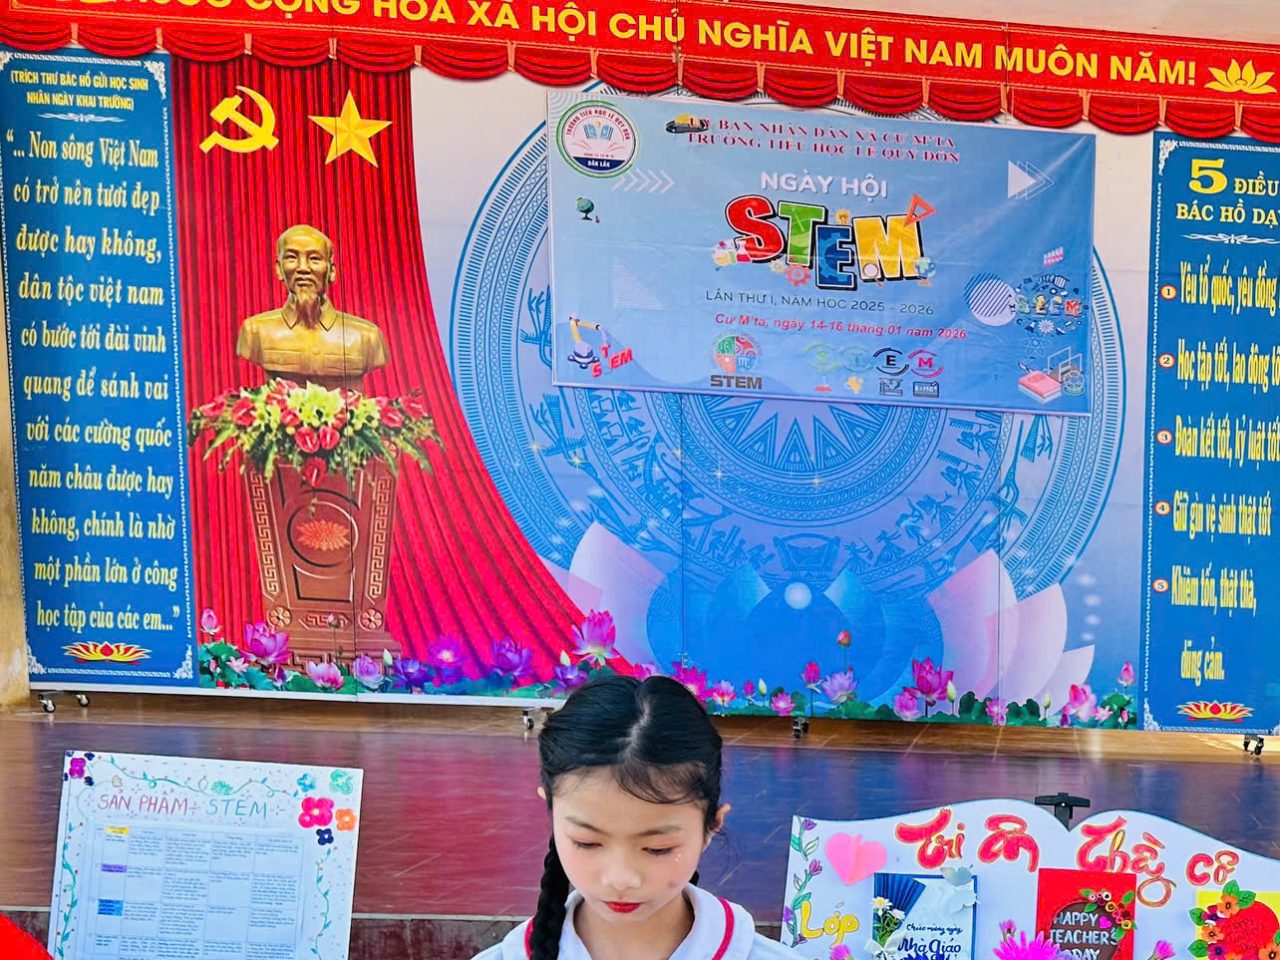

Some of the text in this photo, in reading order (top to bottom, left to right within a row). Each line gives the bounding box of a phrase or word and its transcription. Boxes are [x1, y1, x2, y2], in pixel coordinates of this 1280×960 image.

[531, 1, 597, 42] HỘI
[609, 8, 685, 43] CHỦ
[698, 19, 814, 55] NGHĨA
[825, 27, 894, 67] VIỆT
[904, 37, 983, 69] NAM
[995, 43, 1098, 79] MUÔN
[1109, 51, 1196, 86] NĂM!
[29, 131, 159, 171] Non sông Việt Nam
[760, 169, 887, 202] NGÀY HỘI
[1188, 158, 1279, 196] 5 ĐIỀU
[13, 176, 160, 216] có trở nên tươi đẹp
[1176, 200, 1214, 221] BÁC
[1219, 199, 1246, 223] HỒ
[16, 224, 162, 264] được hay không,
[725, 194, 925, 290] STEM
[19, 272, 164, 309] dân tộc việt nam
[1180, 261, 1196, 304] Yêu
[1199, 254, 1211, 304] tổ
[1211, 259, 1235, 314] quốc,
[1236, 265, 1253, 315] yêu
[1255, 260, 1277, 317] đồng
[850, 300, 934, 316] 2025 2026
[21, 321, 166, 353] có bước tới đài vinh
[810, 319, 843, 332] 14-16
[888, 325, 901, 336] 01
[938, 326, 967, 340] 2026
[23, 366, 168, 401] quang để sánh vai
[710, 374, 762, 390] STEM
[1177, 338, 1195, 390] Học
[1197, 341, 1212, 391] tập
[1214, 336, 1230, 392] tốt,
[1232, 341, 1245, 384] lao
[1248, 342, 1270, 394] động
[26, 415, 172, 452] với các cường quốc
[1175, 414, 1198, 457] Đoàn
[1200, 411, 1215, 459] kết
[1217, 413, 1233, 468] tốt,
[1235, 414, 1246, 468] kỷ
[1248, 418, 1265, 471] luật
[29, 463, 173, 500] năm châu được hay
[32, 508, 176, 541] không, chính là nhờ
[1173, 490, 1272, 544] Giữ gìn vệ sinh thật tốt
[34, 552, 178, 592] một phần lớn ở công
[1171, 562, 1257, 617] Khiêm tốn, thật thà,
[36, 600, 140, 634] học tập của các
[1181, 636, 1225, 687] dũng cảm.
[205, 798, 268, 820] STEM
[895, 808, 966, 869] Tri
[1054, 911, 1098, 927] HAPPY
[897, 937, 961, 953] Nhà Giáo
